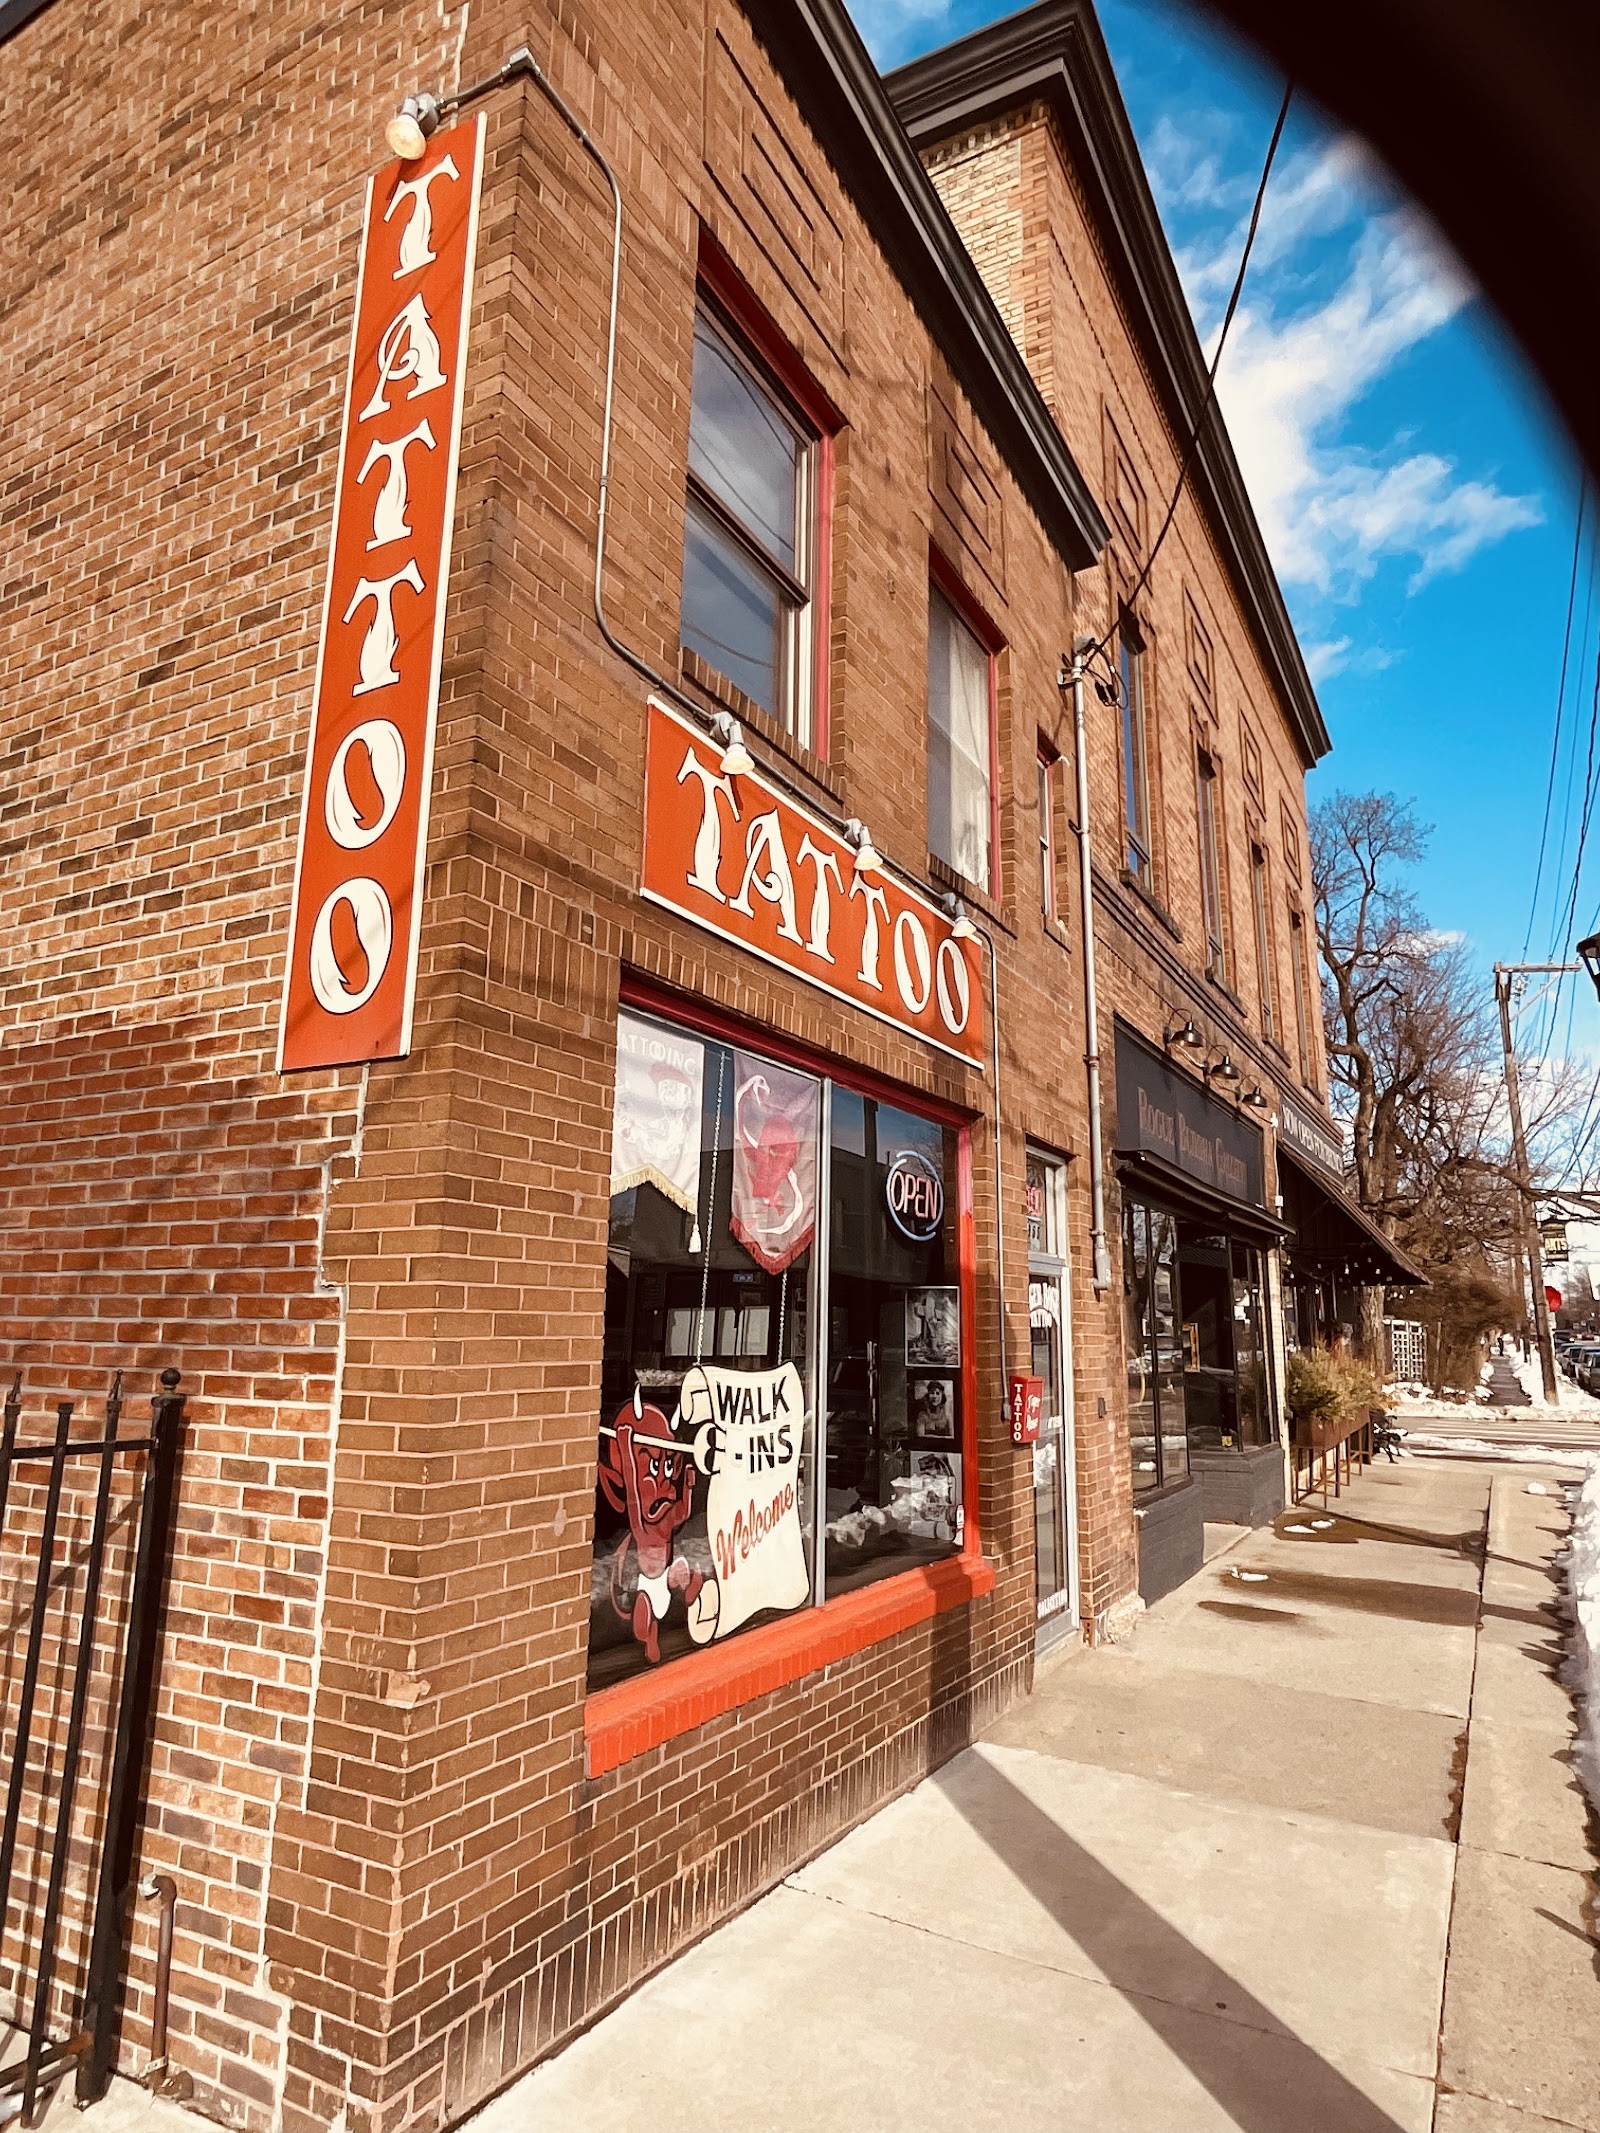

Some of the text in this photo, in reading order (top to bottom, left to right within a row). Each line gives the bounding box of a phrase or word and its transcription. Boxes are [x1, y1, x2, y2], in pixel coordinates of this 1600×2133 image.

[308, 153, 461, 1016] TATTOO
[676, 745, 970, 1035] TATTOO
[619, 1033, 697, 1077] ATTOOING
[890, 1170, 939, 1220] OPEN
[716, 1375, 790, 1425] WALK
[1013, 1383, 1024, 1441] TATTOO
[716, 1482, 794, 1580] Welcome
